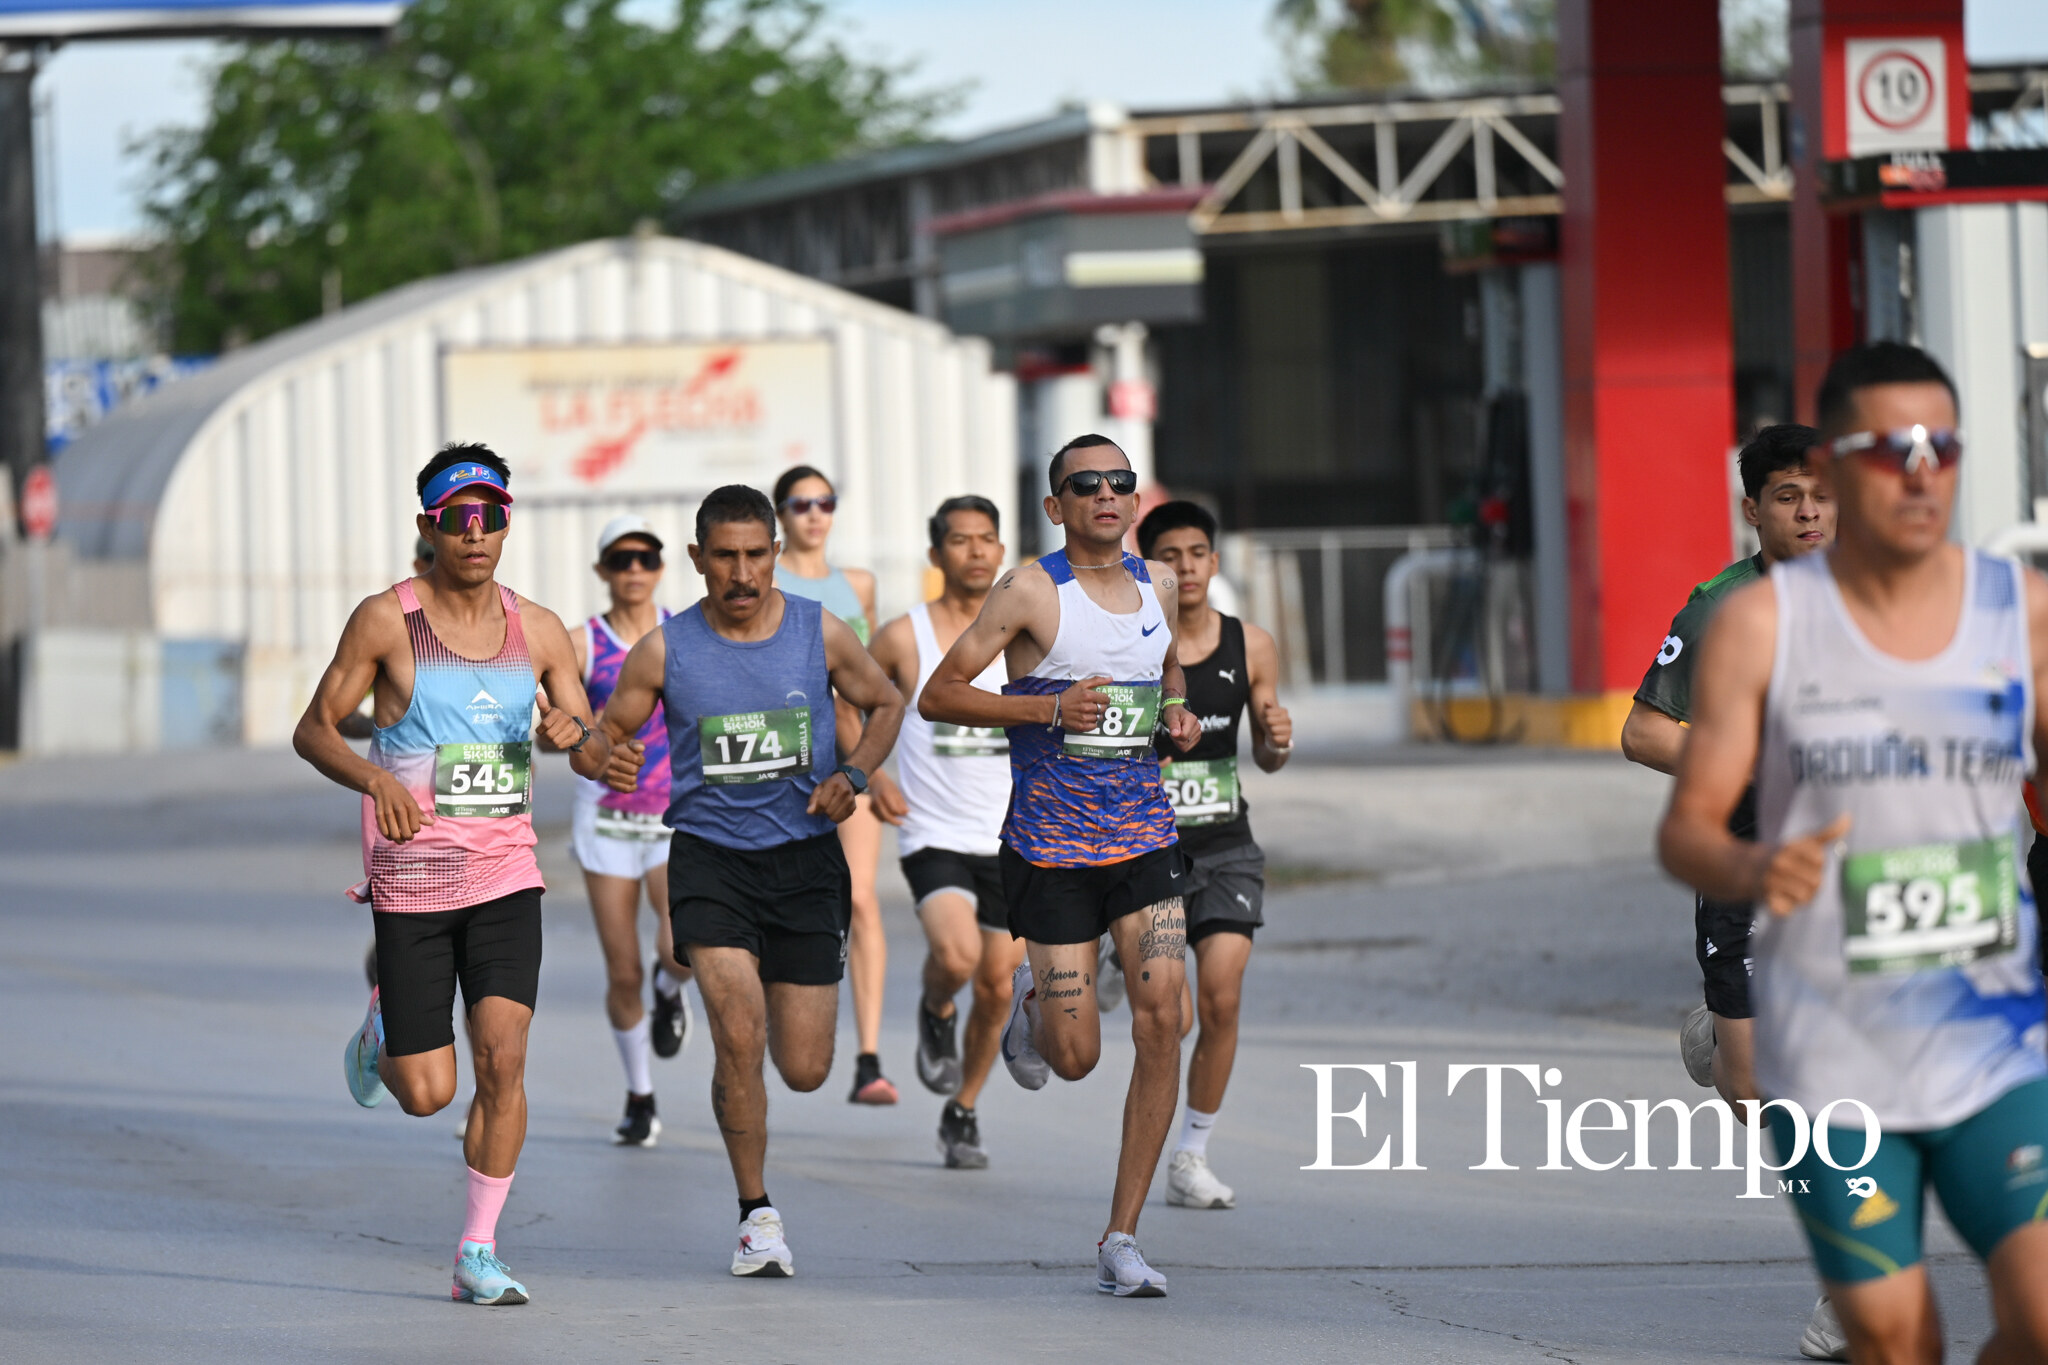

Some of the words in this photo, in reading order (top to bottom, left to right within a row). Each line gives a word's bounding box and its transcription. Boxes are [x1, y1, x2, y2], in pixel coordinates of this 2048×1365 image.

[1877, 69, 1920, 105] 10
[715, 730, 782, 763] 174
[799, 722, 809, 766] MEDALLA
[450, 763, 514, 794] 545
[1163, 777, 1218, 806] 505
[1865, 869, 1982, 935] 595
[1039, 966, 1079, 983] Aurora
